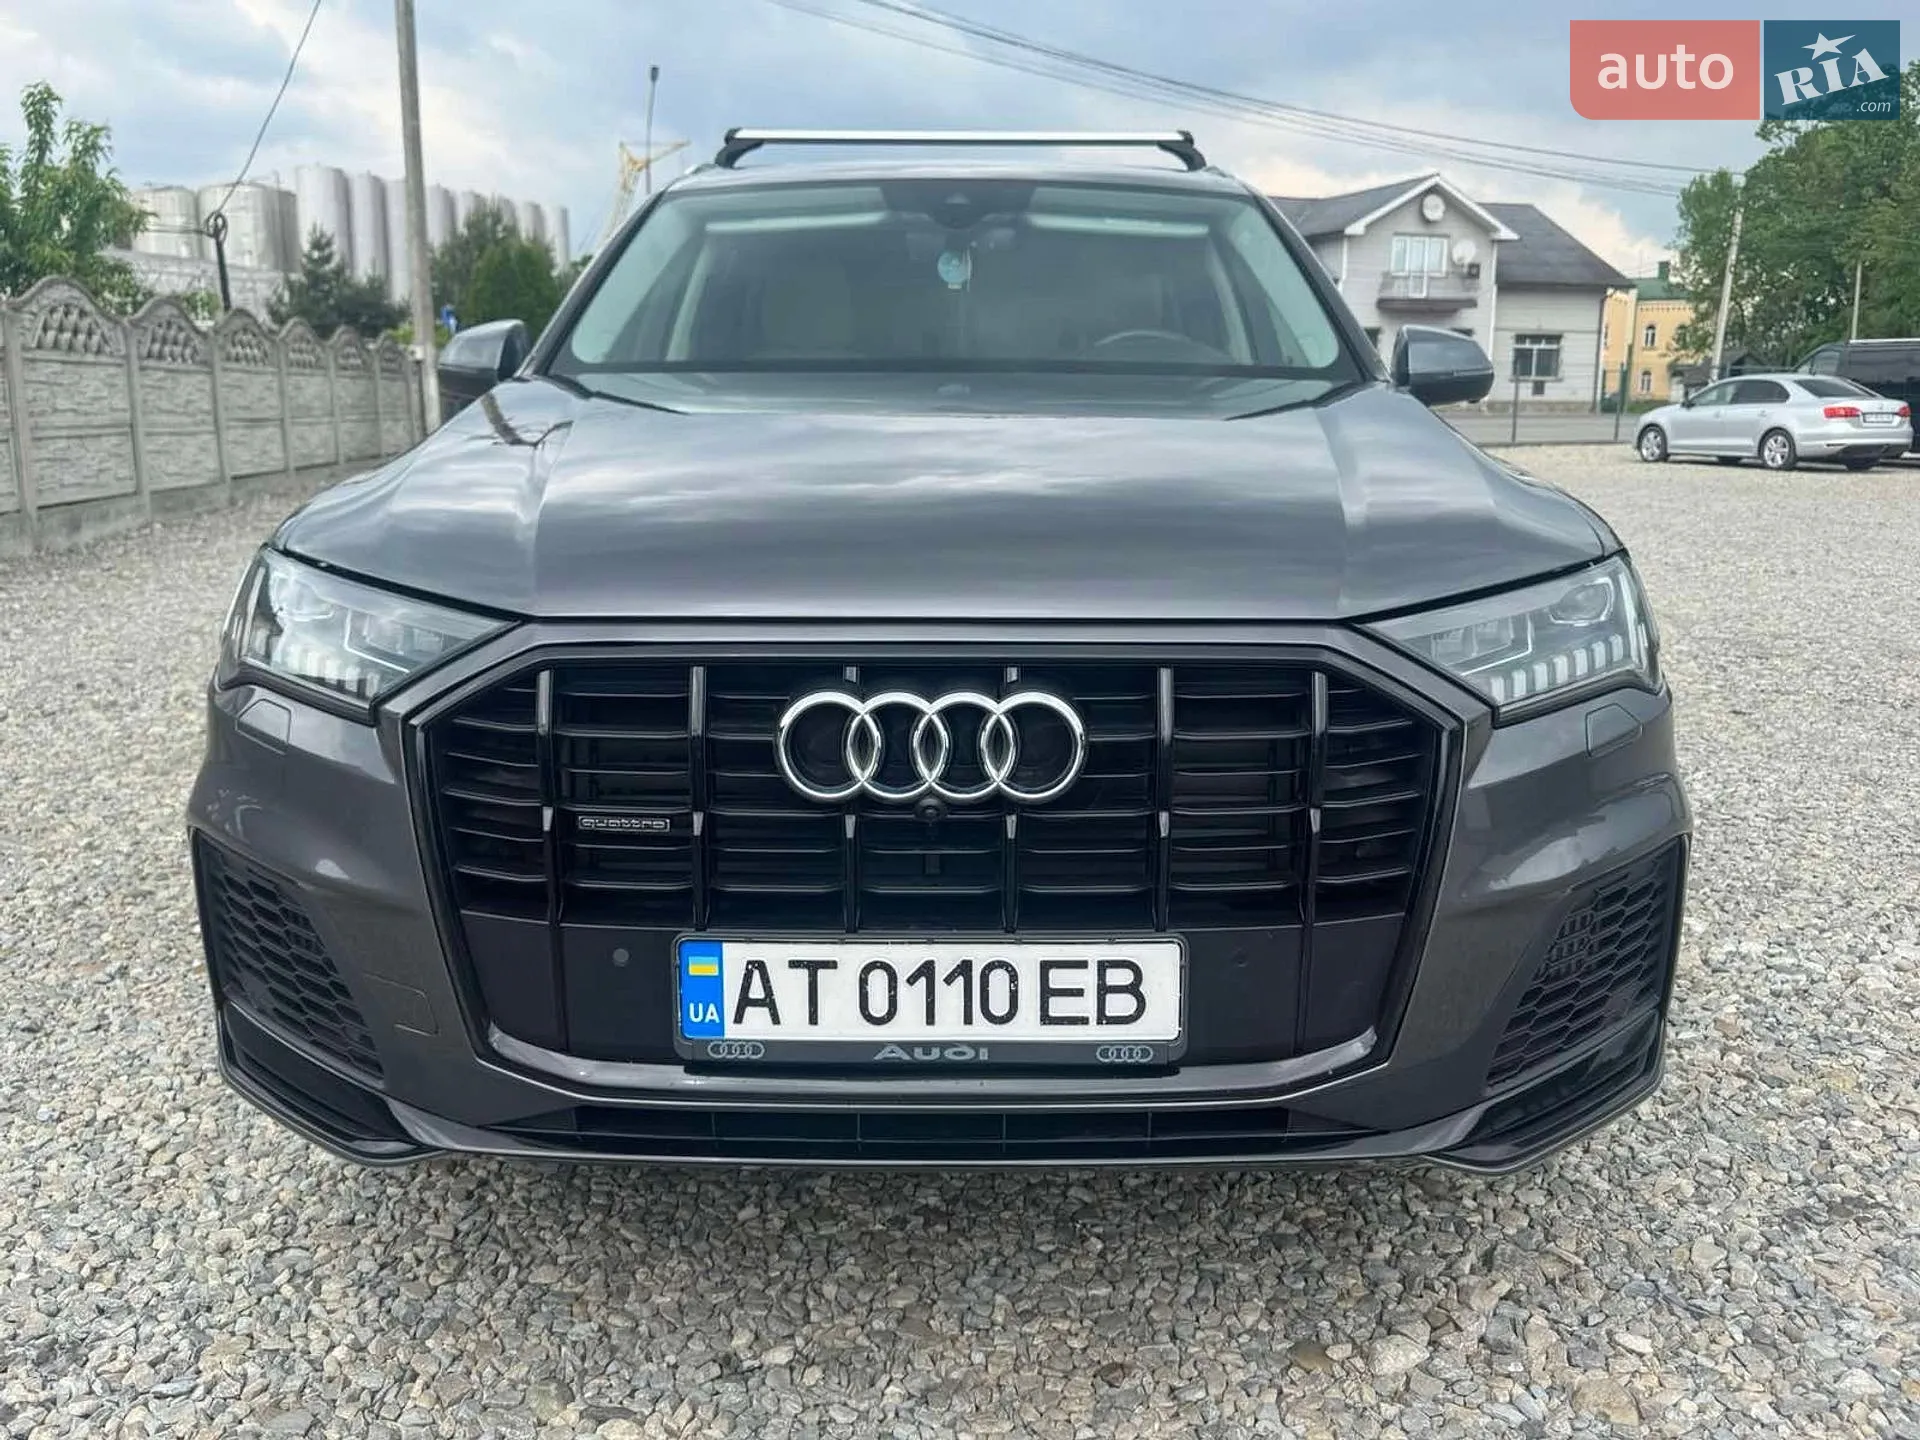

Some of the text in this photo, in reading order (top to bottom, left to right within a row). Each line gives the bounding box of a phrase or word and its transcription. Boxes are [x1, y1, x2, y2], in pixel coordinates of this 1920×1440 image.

[582, 818, 665, 828] quattro
[733, 959, 1145, 1026] AT 0110 EB
[689, 1003, 720, 1024] UA
